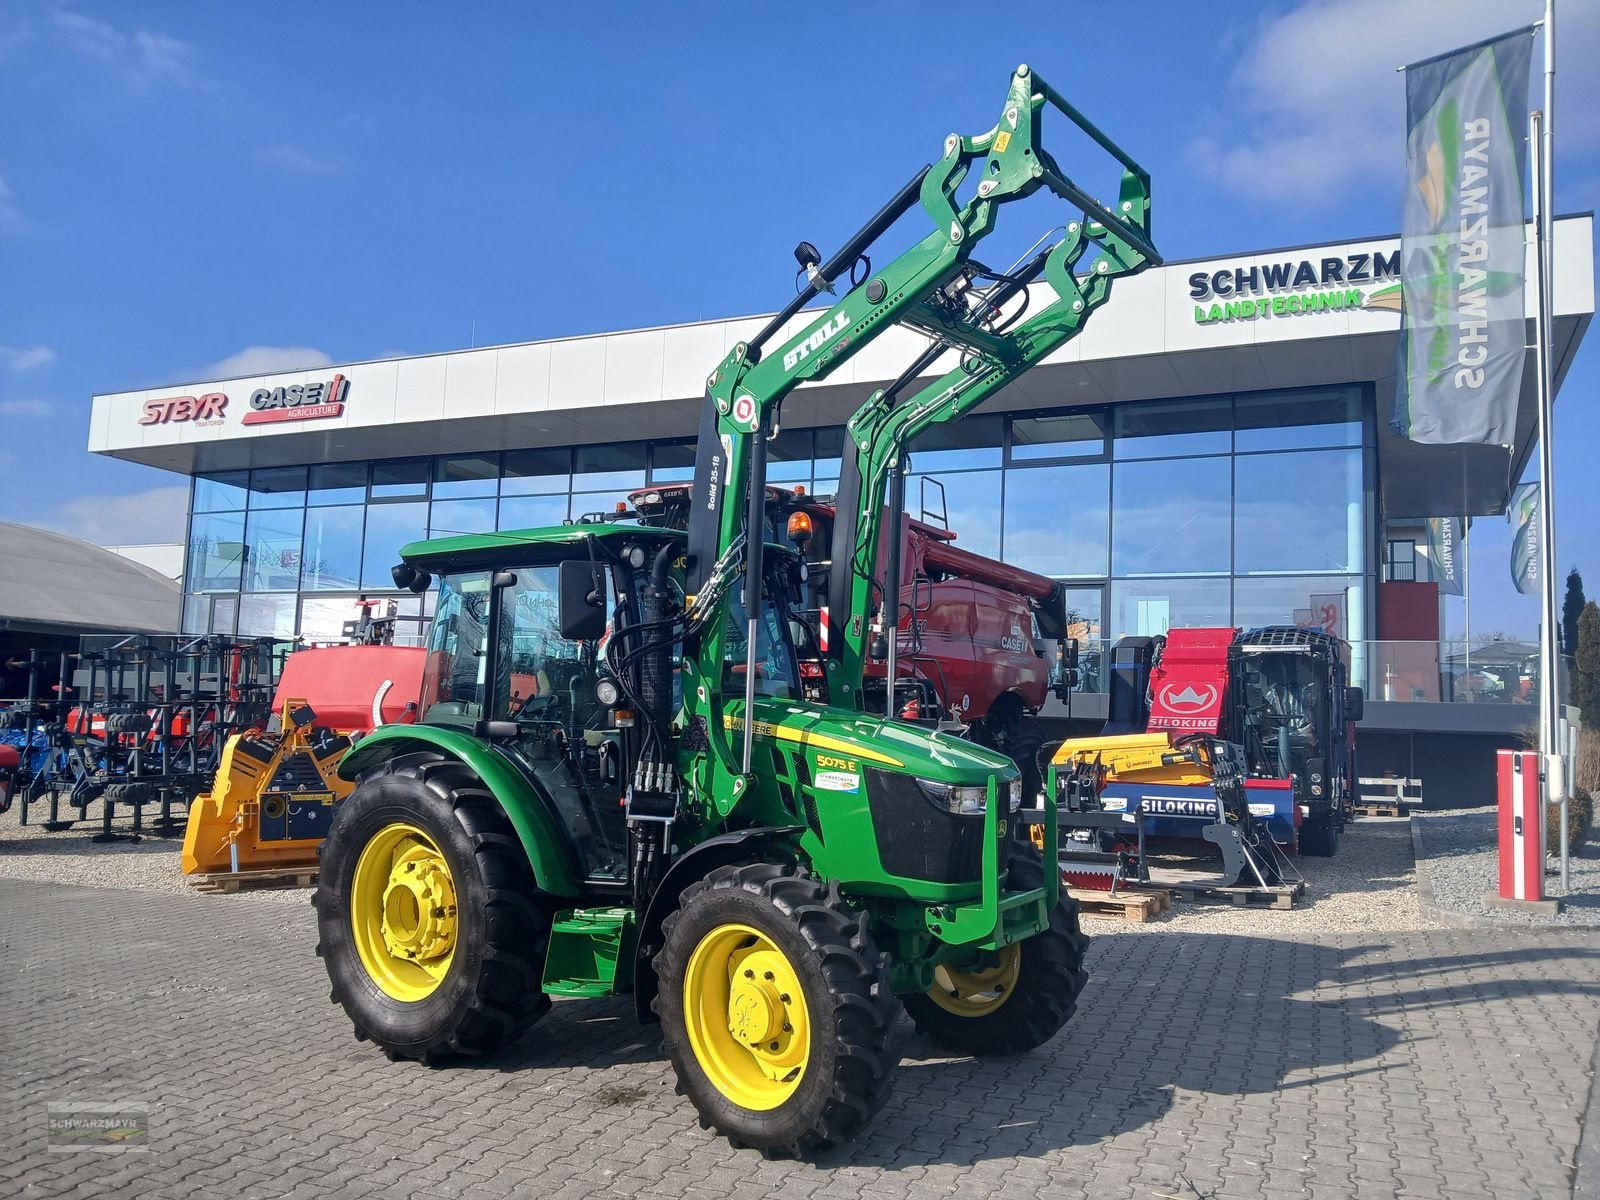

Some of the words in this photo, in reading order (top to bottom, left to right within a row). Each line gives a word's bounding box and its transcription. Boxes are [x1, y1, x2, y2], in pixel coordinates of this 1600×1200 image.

[1188, 247, 1402, 300] SCHWARZM
[1194, 288, 1361, 323] LANDTECHNIK
[783, 311, 851, 372] STOLL
[138, 392, 229, 425] STEYR
[287, 405, 337, 418] AGRICULTURE
[195, 419, 225, 428] TRAKTOREN
[710, 455, 720, 483] 35-18
[707, 484, 717, 511] Solid
[725, 719, 744, 730] OHN
[1149, 718, 1218, 728] SILOKING
[816, 754, 847, 770] 5075
[848, 761, 857, 772] E
[1141, 800, 1217, 816] SILOKING
